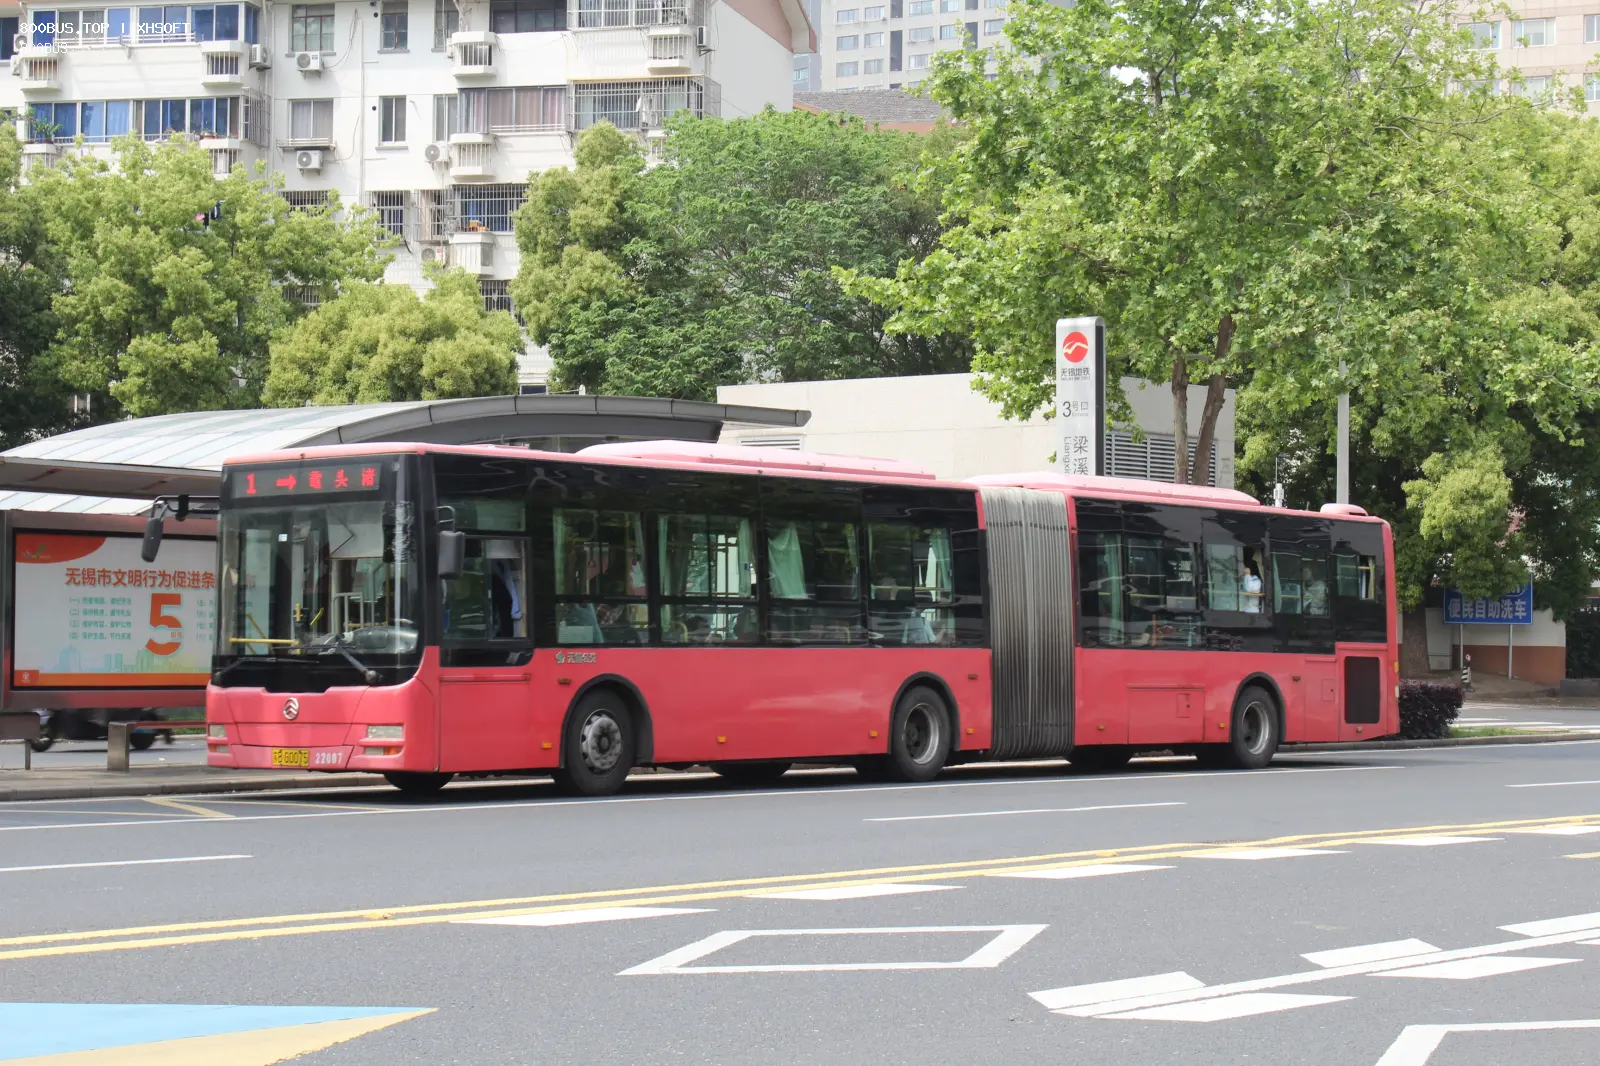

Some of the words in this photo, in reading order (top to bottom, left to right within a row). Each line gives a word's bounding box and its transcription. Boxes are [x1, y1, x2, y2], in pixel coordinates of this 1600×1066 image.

[1060, 367, 1090, 377] 无锡地铁
[245, 473, 256, 495] 1
[65, 567, 216, 590] 无锡市文明行为促进条
[1449, 598, 1527, 619] 便民自助洗车
[315, 752, 343, 765] 22007
